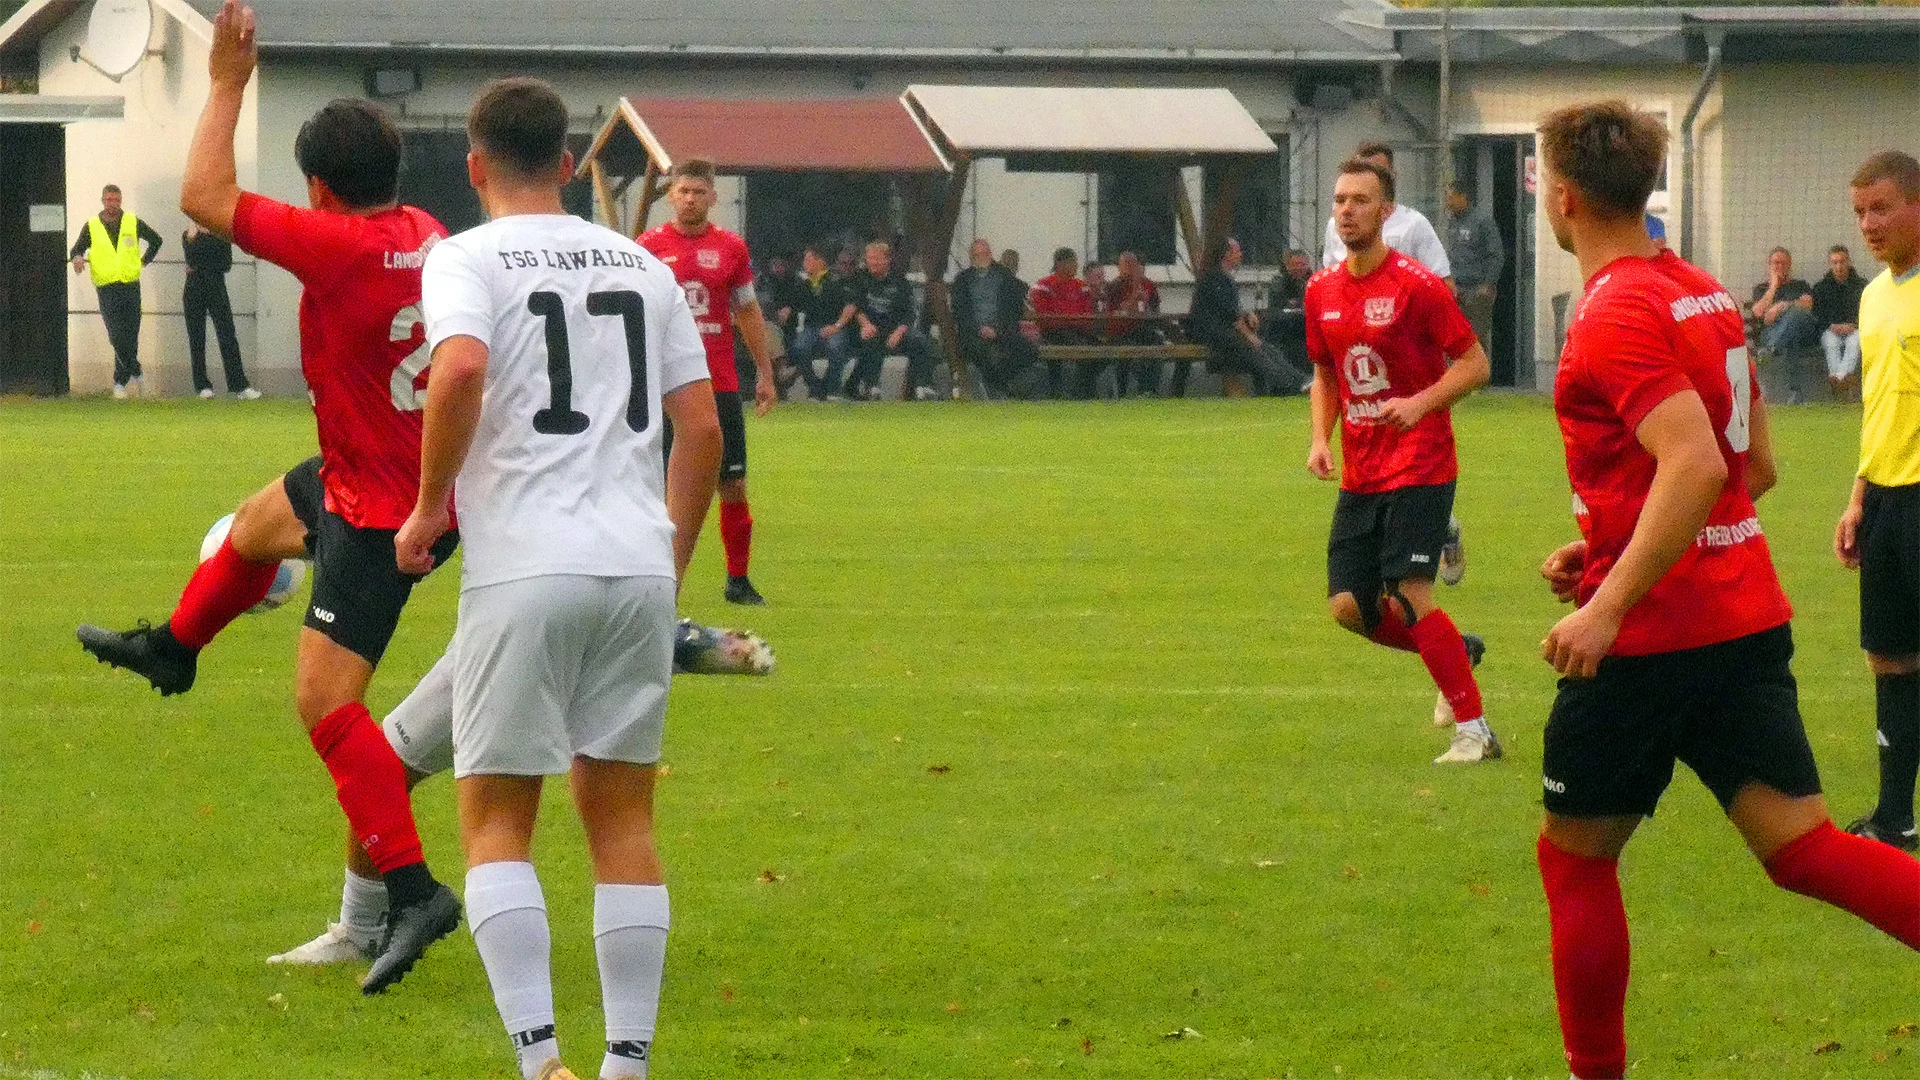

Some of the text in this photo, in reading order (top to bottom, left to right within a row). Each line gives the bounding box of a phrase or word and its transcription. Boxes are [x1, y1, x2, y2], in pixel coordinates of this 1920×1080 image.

[499, 249, 647, 272] TSG LAWALDE
[389, 300, 432, 412] 2
[527, 290, 649, 434] 17
[1543, 775, 1566, 794] AKO
